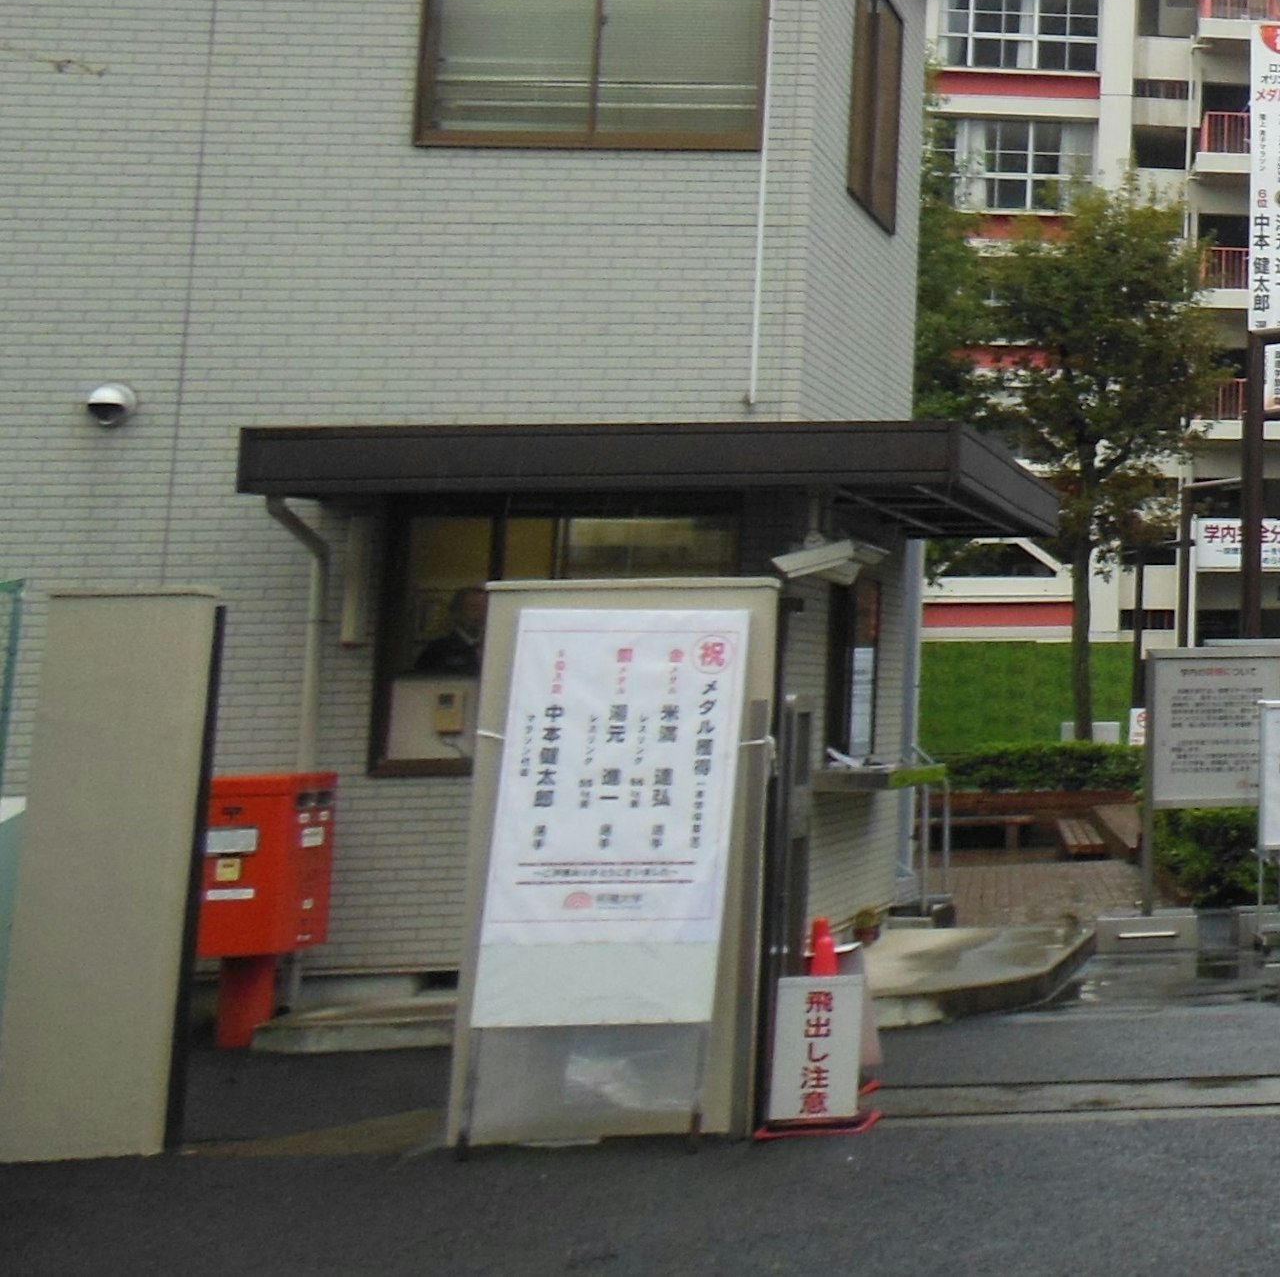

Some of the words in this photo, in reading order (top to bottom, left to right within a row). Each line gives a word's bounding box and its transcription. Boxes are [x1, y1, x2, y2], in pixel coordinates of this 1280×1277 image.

[1253, 213, 1270, 251] 中本
[1253, 257, 1270, 313] 健太郎
[700, 641, 725, 668] 祝
[533, 704, 564, 807] 中本健太郎
[694, 680, 718, 775] メダル獲得
[800, 990, 833, 1114] 飛出し注意
